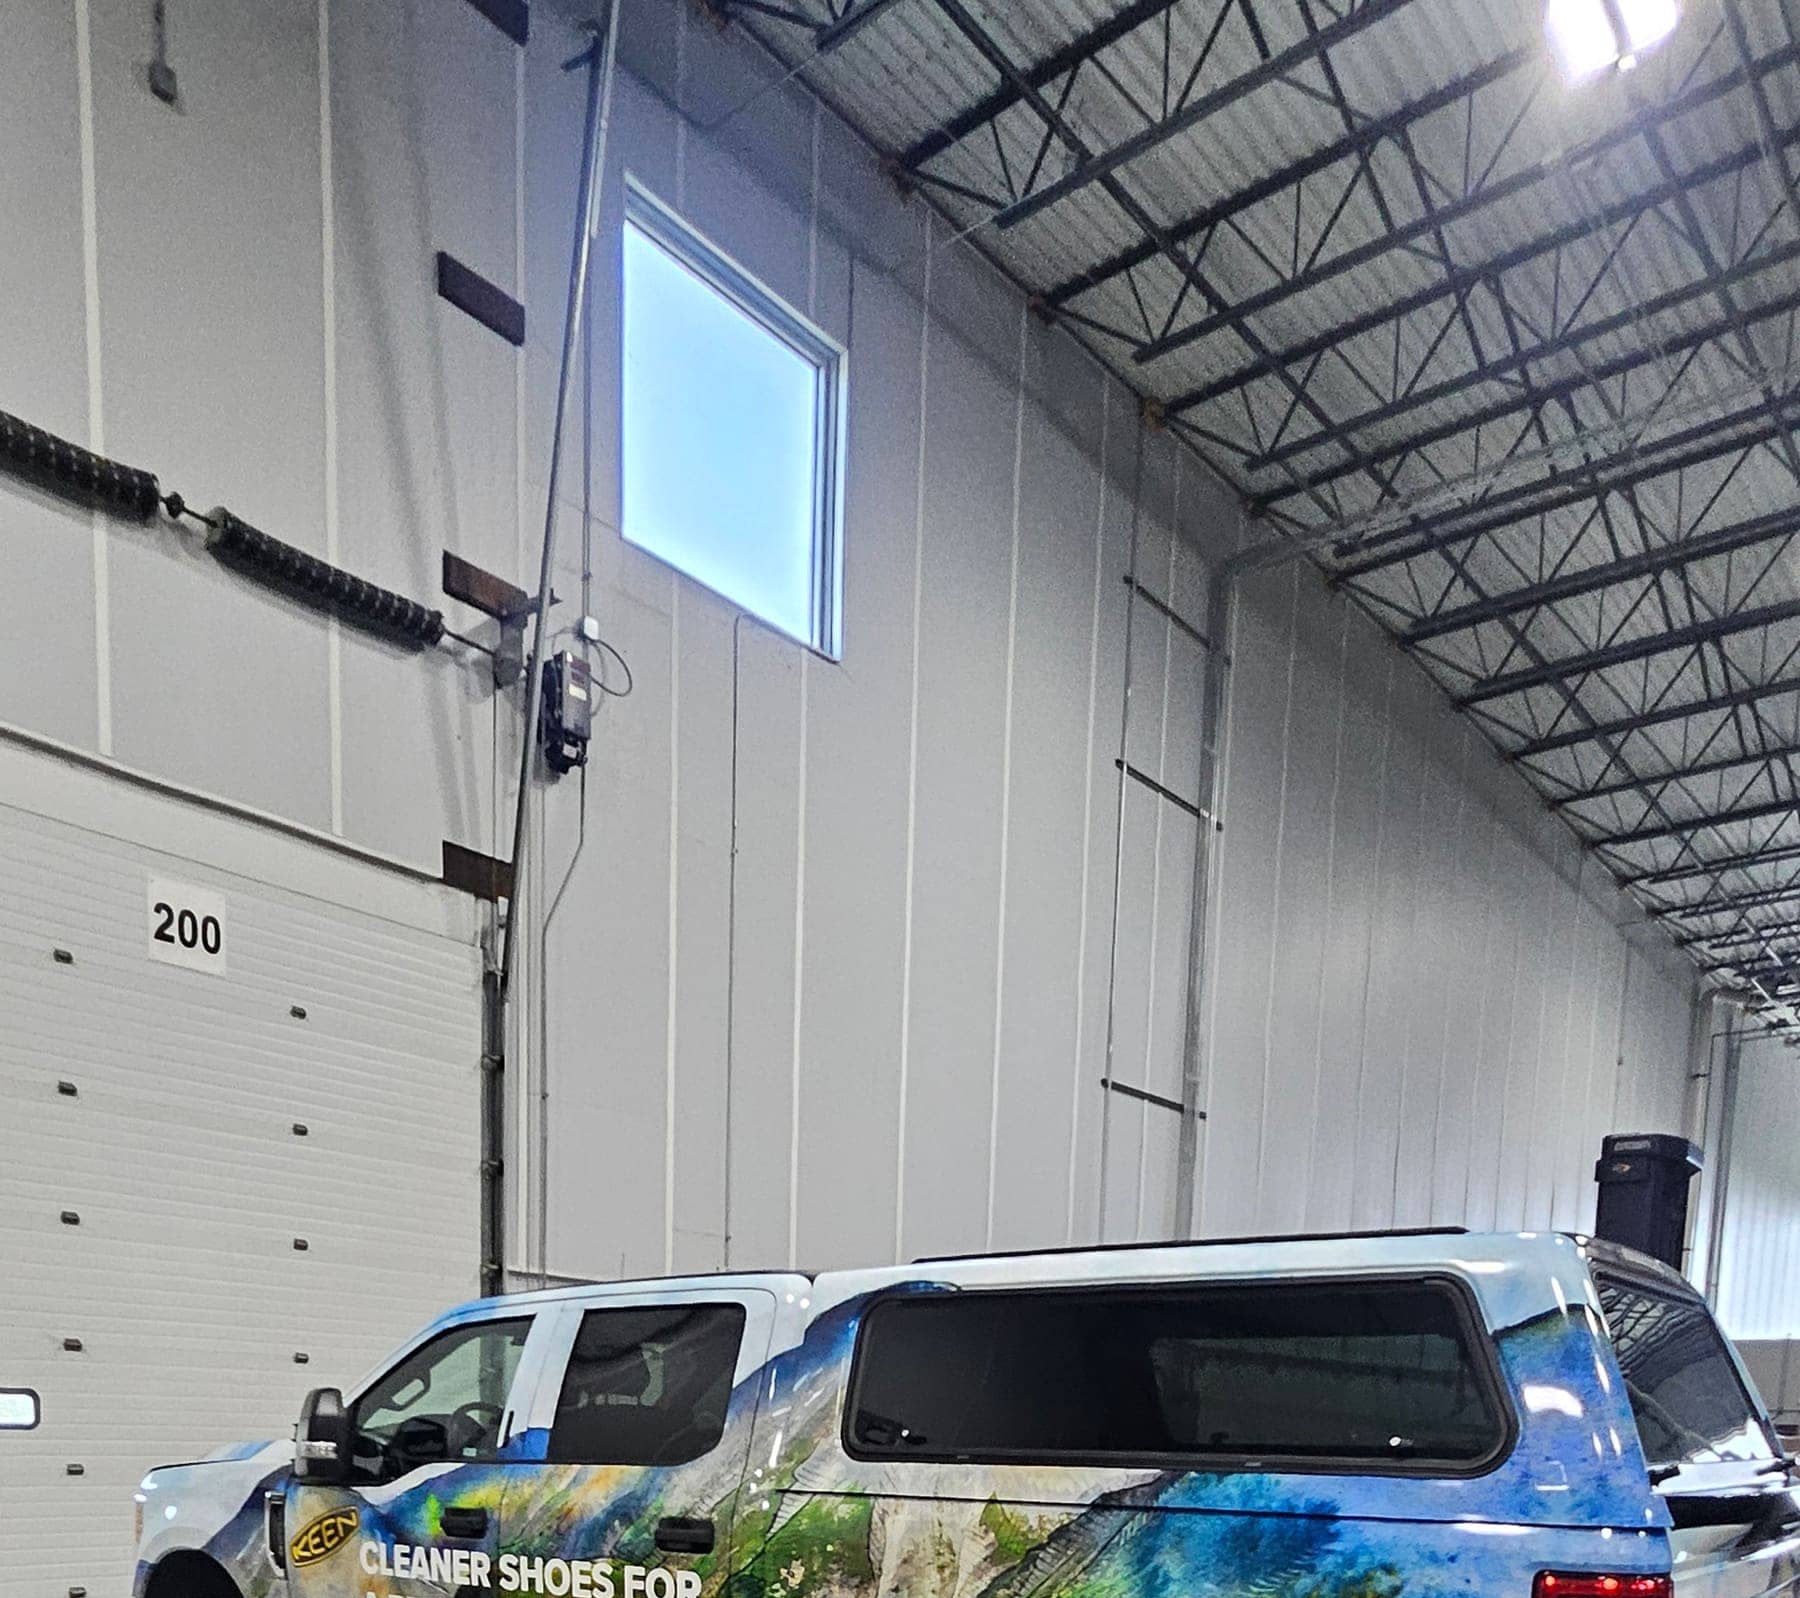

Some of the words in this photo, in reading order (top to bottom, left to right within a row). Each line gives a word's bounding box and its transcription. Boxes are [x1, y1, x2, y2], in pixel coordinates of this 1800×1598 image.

[153, 902, 221, 955] 200
[292, 1511, 358, 1561] KEEN
[359, 1540, 492, 1588] CLEANER
